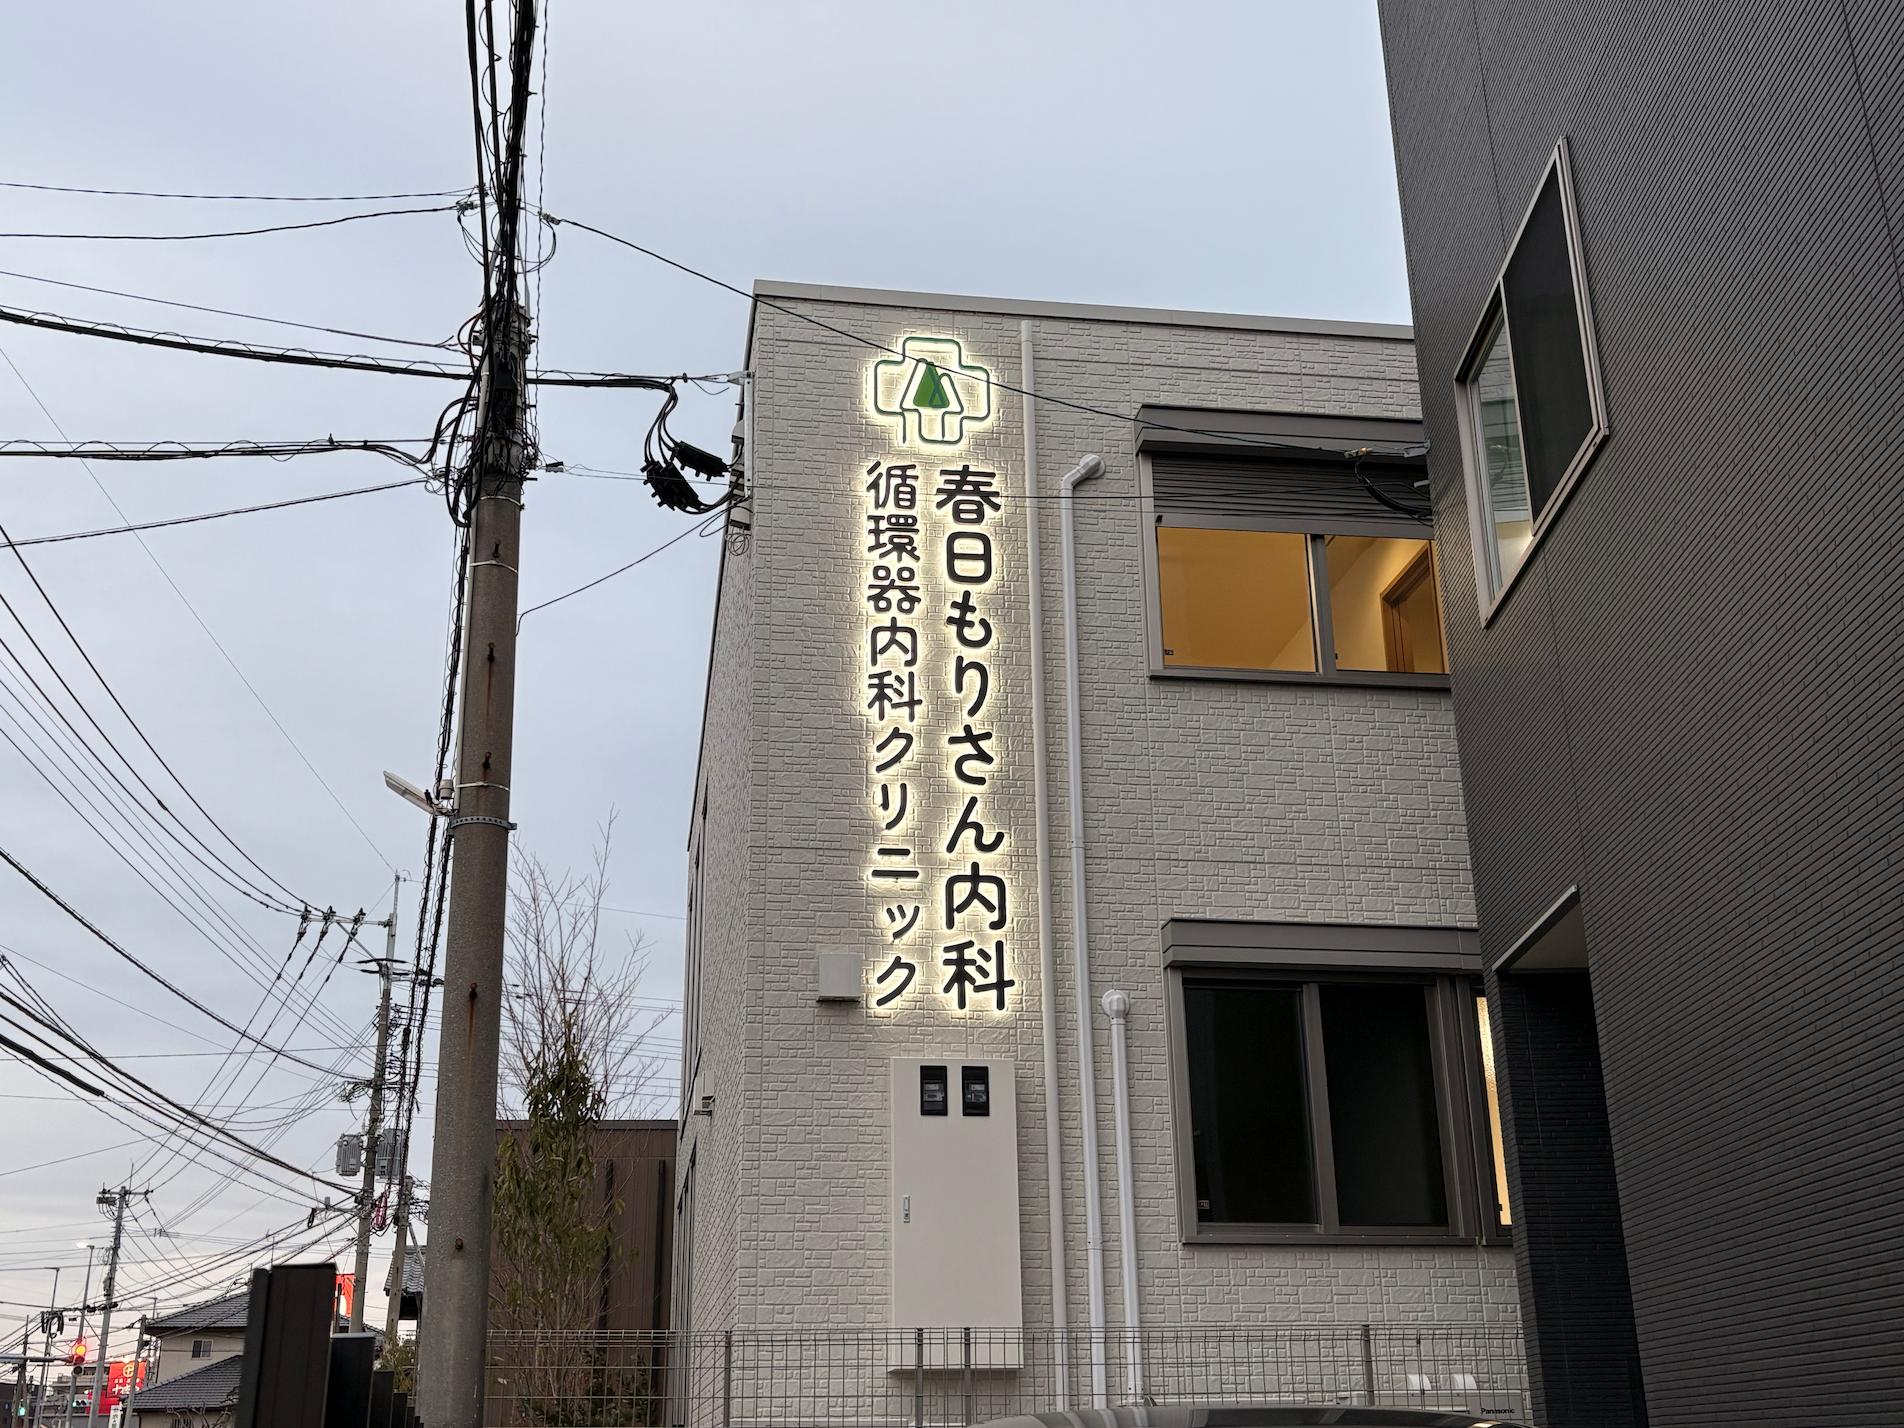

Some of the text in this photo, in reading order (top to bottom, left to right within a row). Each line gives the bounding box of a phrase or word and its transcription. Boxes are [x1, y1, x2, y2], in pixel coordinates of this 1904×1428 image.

[866, 460, 923, 1007] 循環器内科クリニック
[935, 464, 1015, 1011] 春日もりさん内科
[1480, 1407, 1515, 1415] Panasonic
